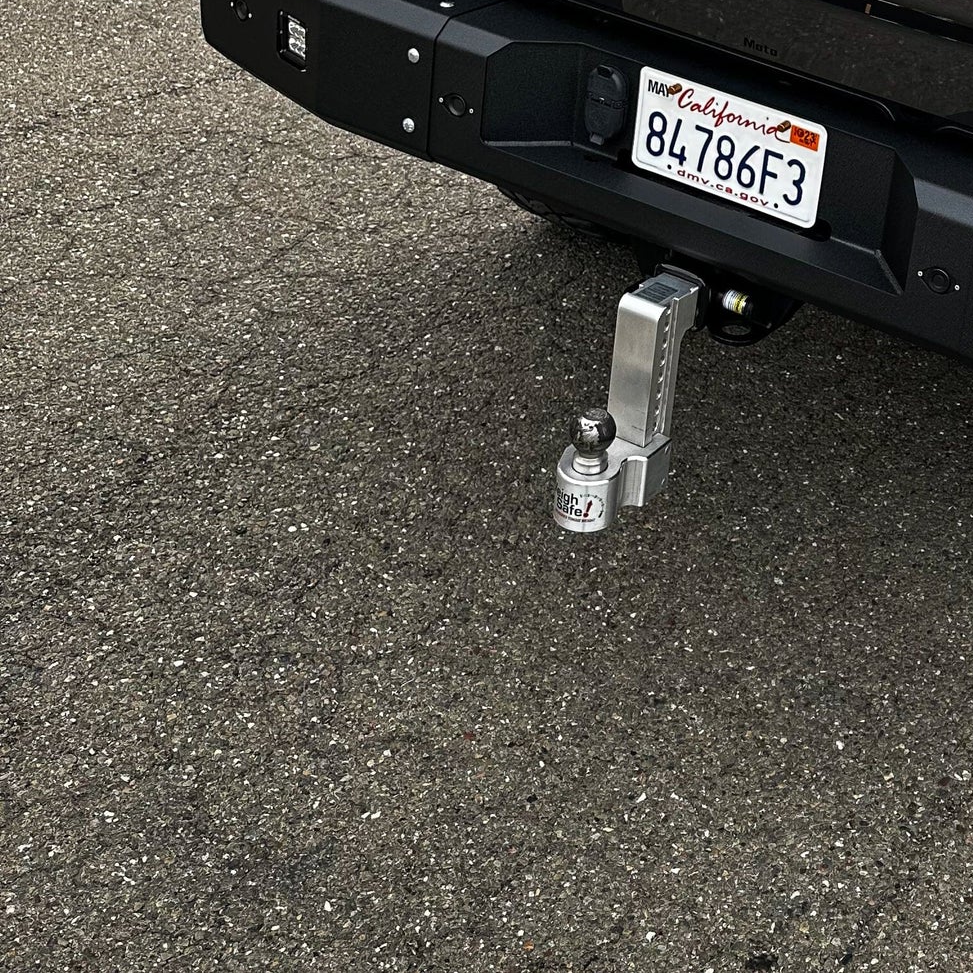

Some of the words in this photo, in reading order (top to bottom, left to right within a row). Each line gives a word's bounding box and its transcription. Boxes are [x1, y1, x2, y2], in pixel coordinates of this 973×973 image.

[647, 79, 670, 98] MAY
[677, 88, 790, 143] California
[645, 111, 806, 206] 84786F3
[677, 168, 769, 207] dmv.ca.gov
[557, 488, 579, 506] eigh
